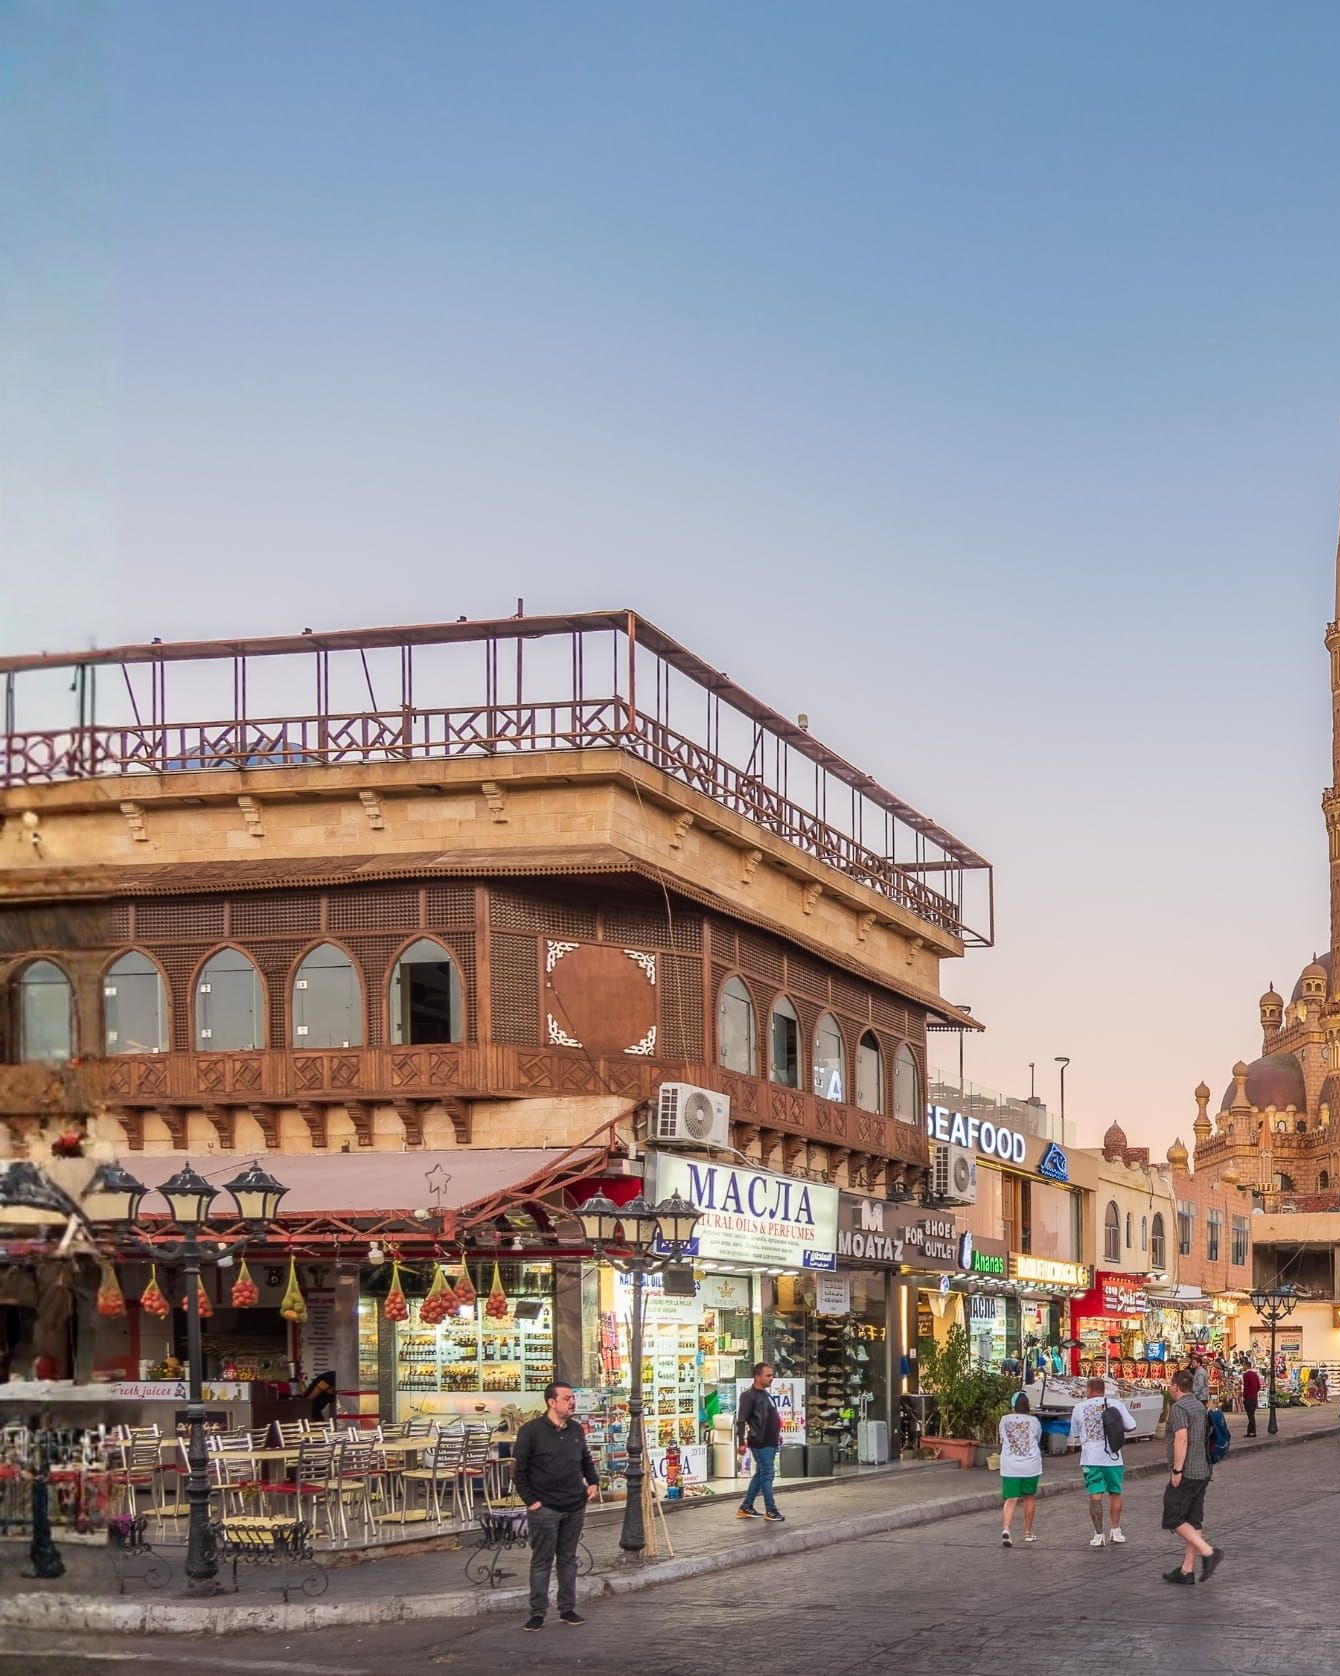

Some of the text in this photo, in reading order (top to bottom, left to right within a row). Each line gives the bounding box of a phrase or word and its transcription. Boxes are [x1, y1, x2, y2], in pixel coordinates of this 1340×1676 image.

[687, 1164, 815, 1225] МАСЛА
[735, 1217, 758, 1234] OILS
[759, 1222, 767, 1234] &
[768, 1222, 815, 1241] PERFUMES
[905, 1226, 924, 1246] FOR
[925, 1219, 956, 1239] SHOES
[838, 1230, 904, 1262] MOATAZ
[925, 1242, 956, 1260] OUTLET
[974, 1251, 1004, 1274] Ananas
